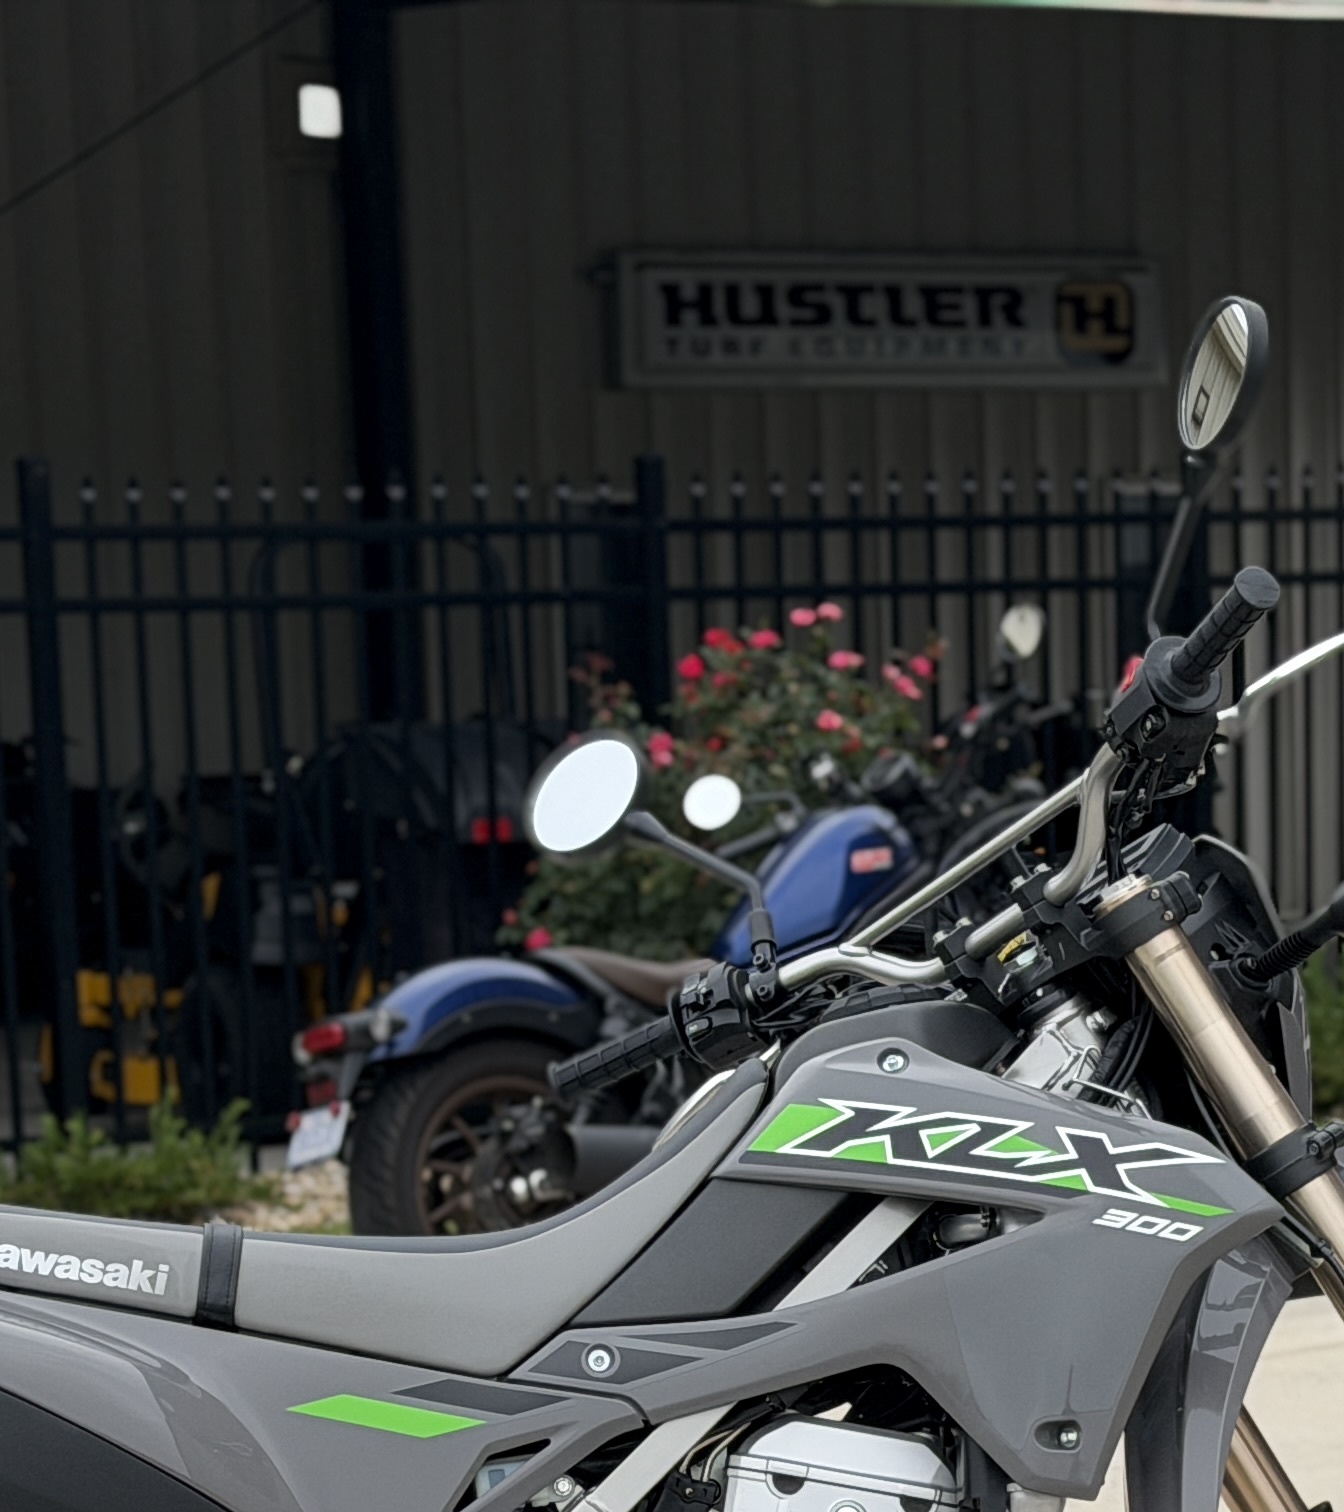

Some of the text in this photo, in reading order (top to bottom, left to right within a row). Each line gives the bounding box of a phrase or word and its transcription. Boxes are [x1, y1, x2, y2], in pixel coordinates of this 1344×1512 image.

[659, 282, 1027, 328] HUSTLER
[664, 335, 1028, 358] TURF EQUIPMENT
[774, 1097, 1227, 1207] KLX
[1092, 1208, 1204, 1242] 300
